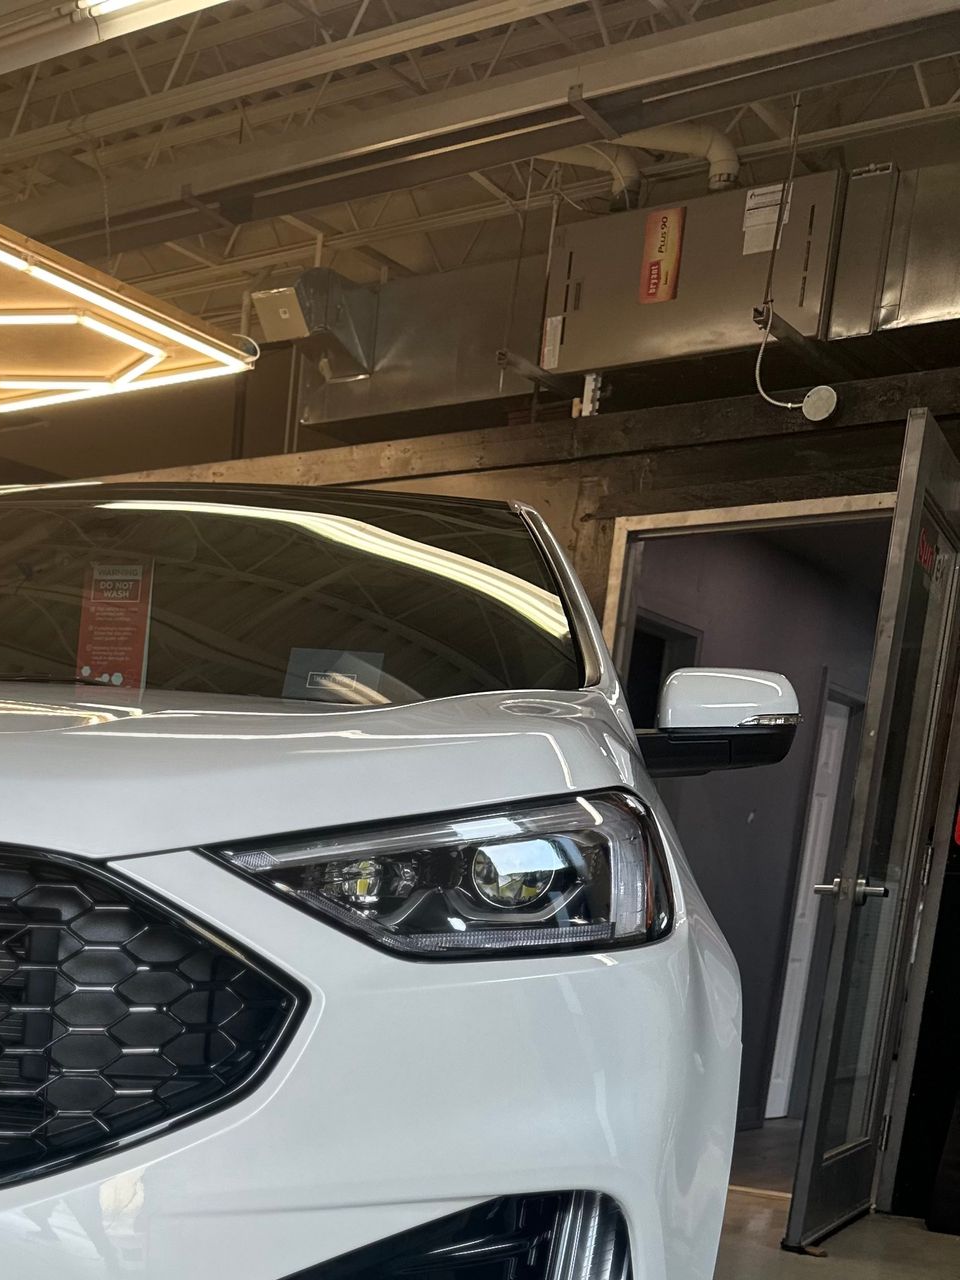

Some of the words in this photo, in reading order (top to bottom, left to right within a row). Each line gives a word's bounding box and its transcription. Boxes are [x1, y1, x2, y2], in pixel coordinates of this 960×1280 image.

[661, 216, 668, 230] 90
[97, 567, 139, 577] WARNING
[100, 581, 113, 589] DO
[115, 582, 133, 590] NOT
[103, 590, 129, 598] WASH
